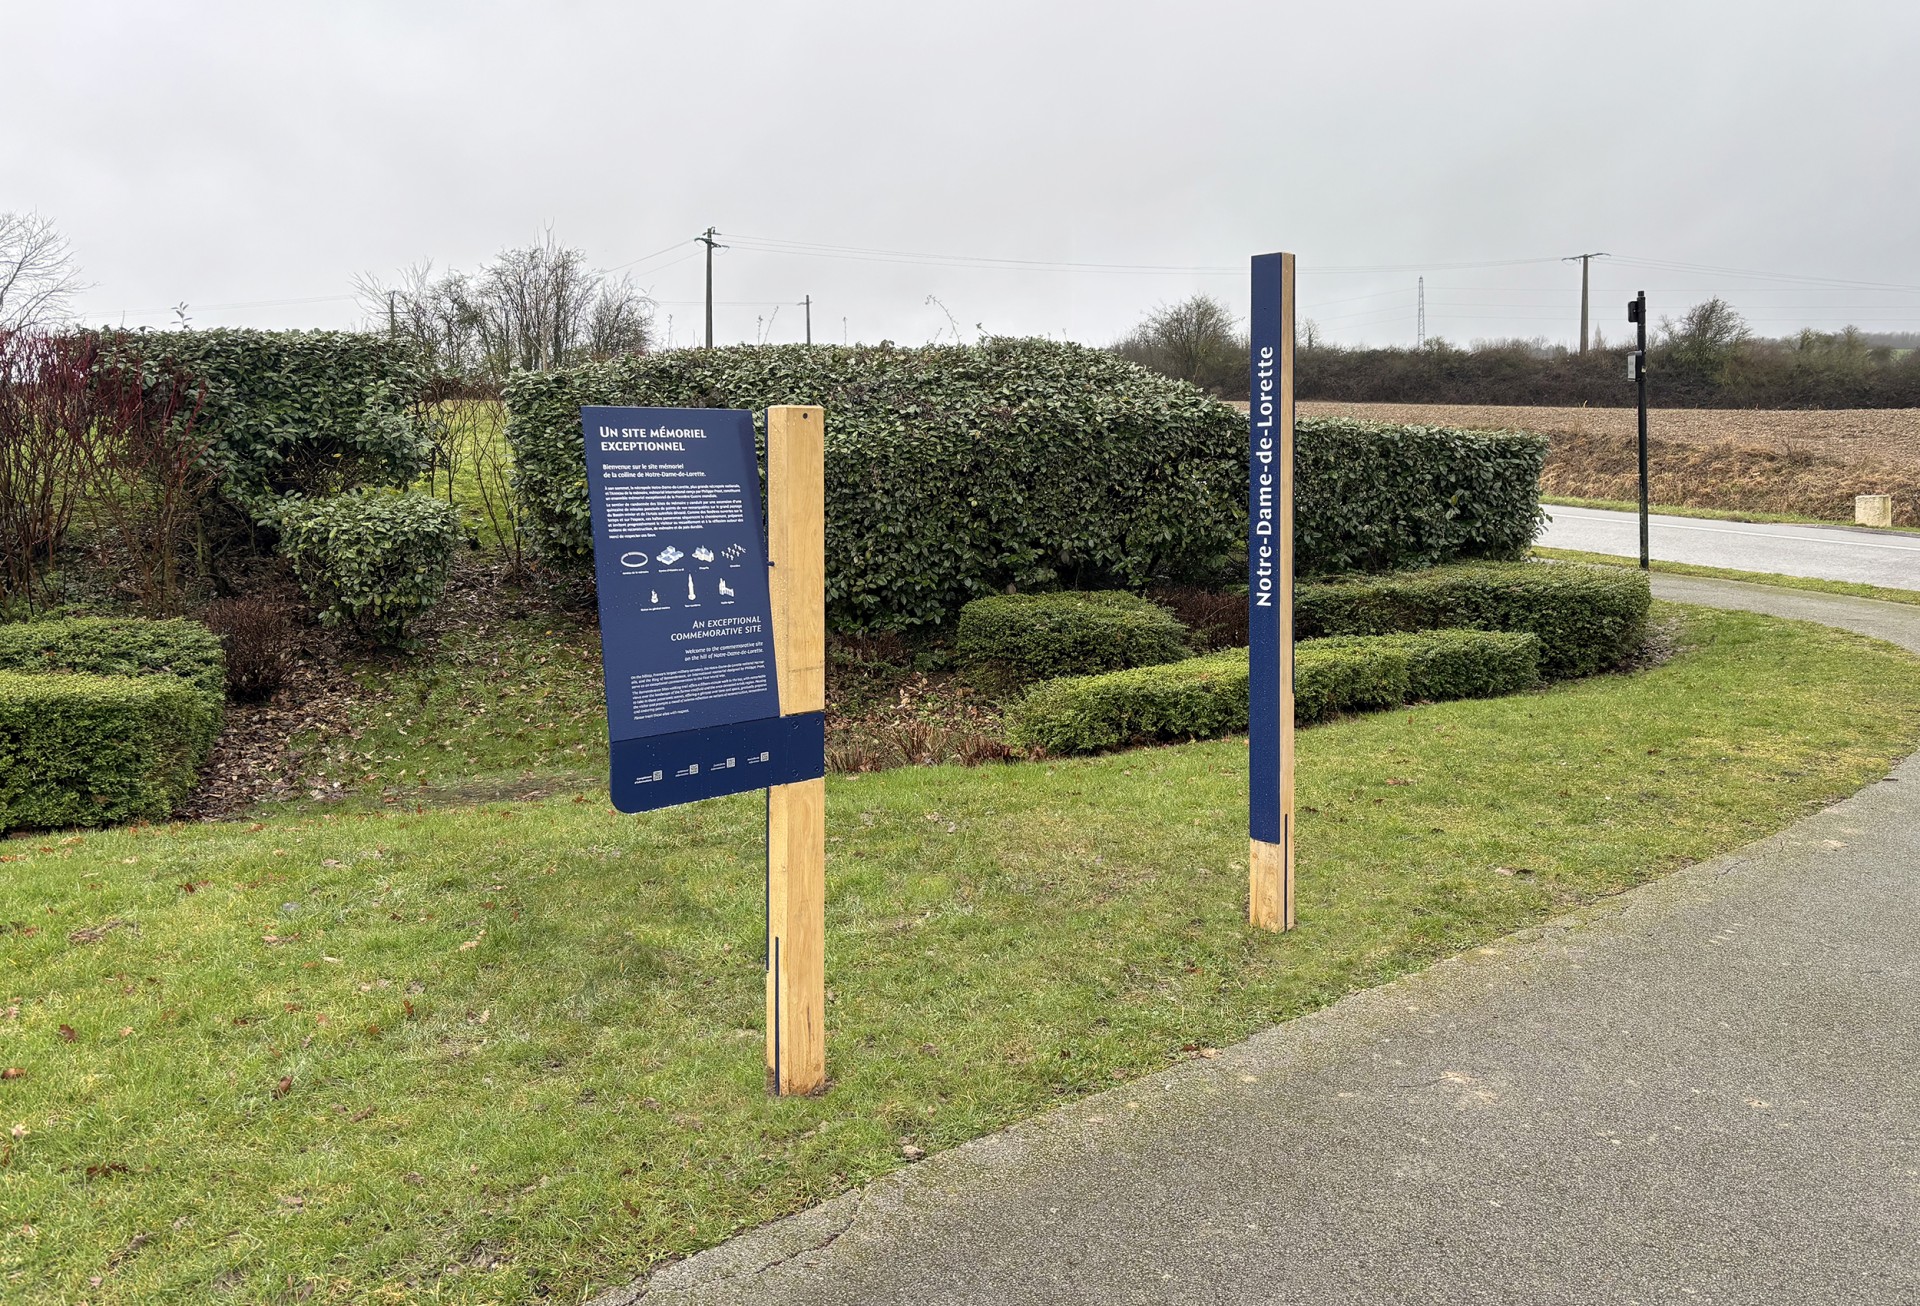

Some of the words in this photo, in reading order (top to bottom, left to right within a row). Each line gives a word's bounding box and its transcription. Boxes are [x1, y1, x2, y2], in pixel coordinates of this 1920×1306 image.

[622, 428, 646, 438] SITE
[650, 426, 706, 438] MÉMORIEL
[601, 442, 685, 451] EXCEPTIONNEL
[1256, 346, 1273, 607] Notre-Dame-de-Lorette
[707, 616, 761, 628] EXCEPTIONAL
[670, 627, 743, 641] COMMEMORATIVE
[745, 624, 762, 634] SITE
[720, 642, 755, 650] commemorative
